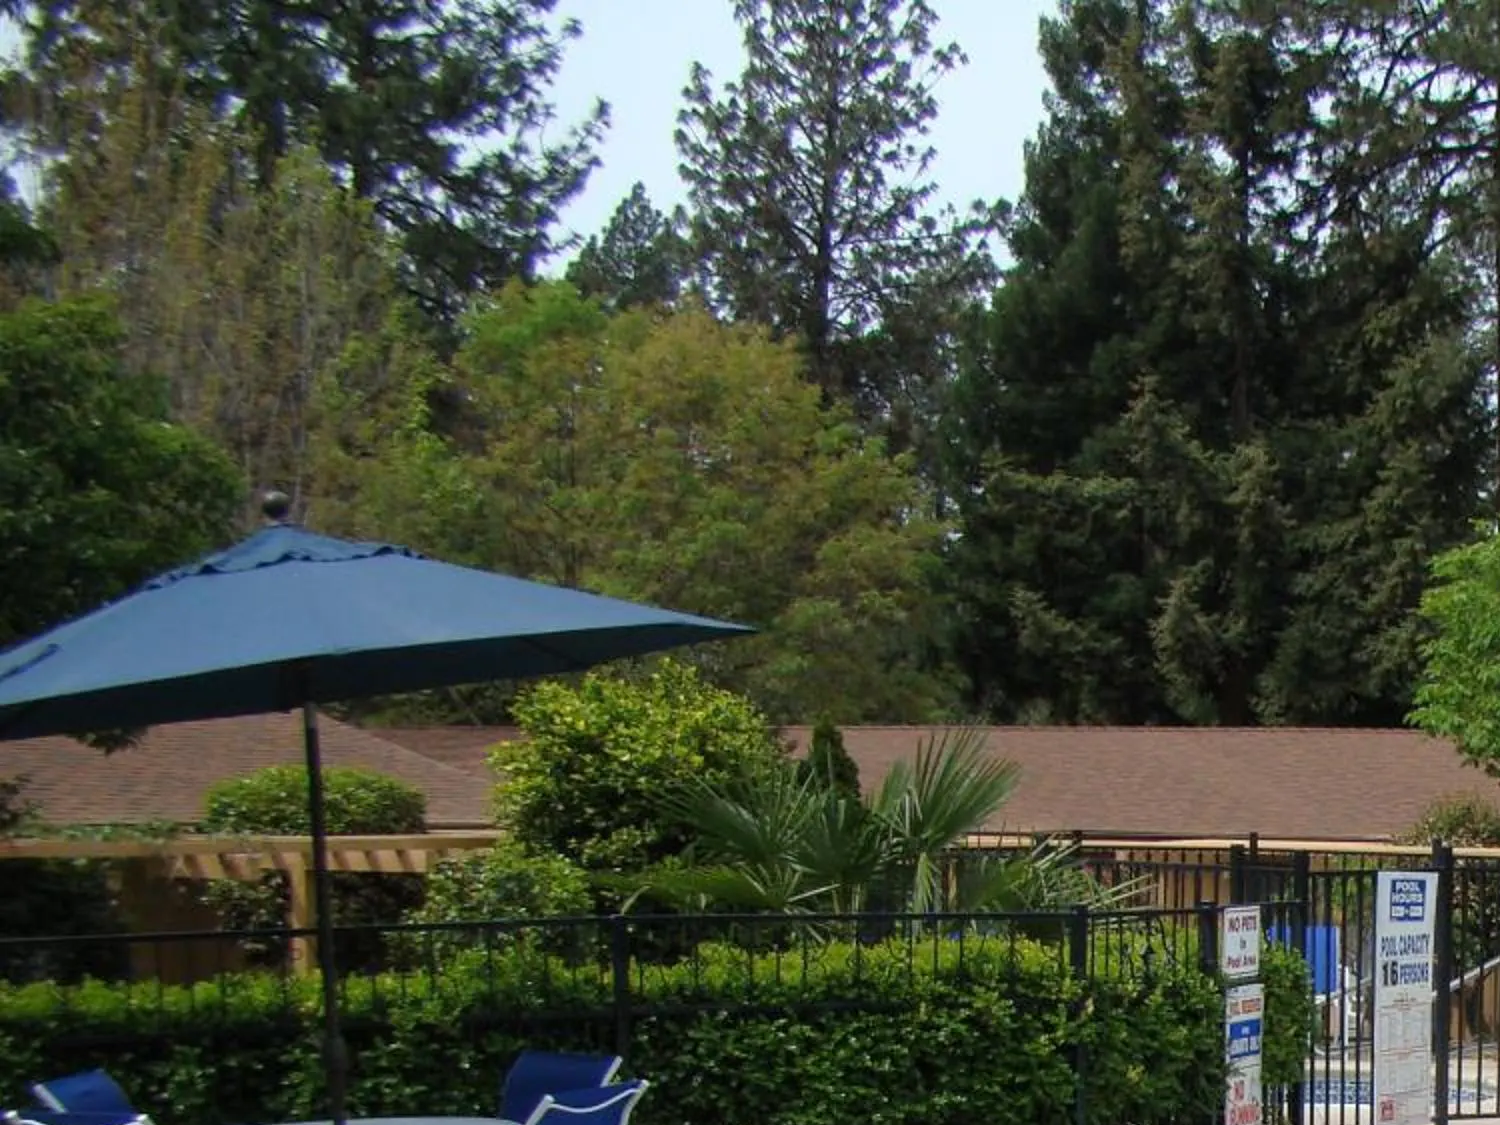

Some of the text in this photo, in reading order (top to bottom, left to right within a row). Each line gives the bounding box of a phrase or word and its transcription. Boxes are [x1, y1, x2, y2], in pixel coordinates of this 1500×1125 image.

[1395, 881, 1421, 893] POOL
[1391, 893, 1423, 904] HOURS
[1228, 916, 1240, 932] NO
[1381, 933, 1430, 957] POOL CAPACITY
[1382, 961, 1428, 986] 16 PERSONS
